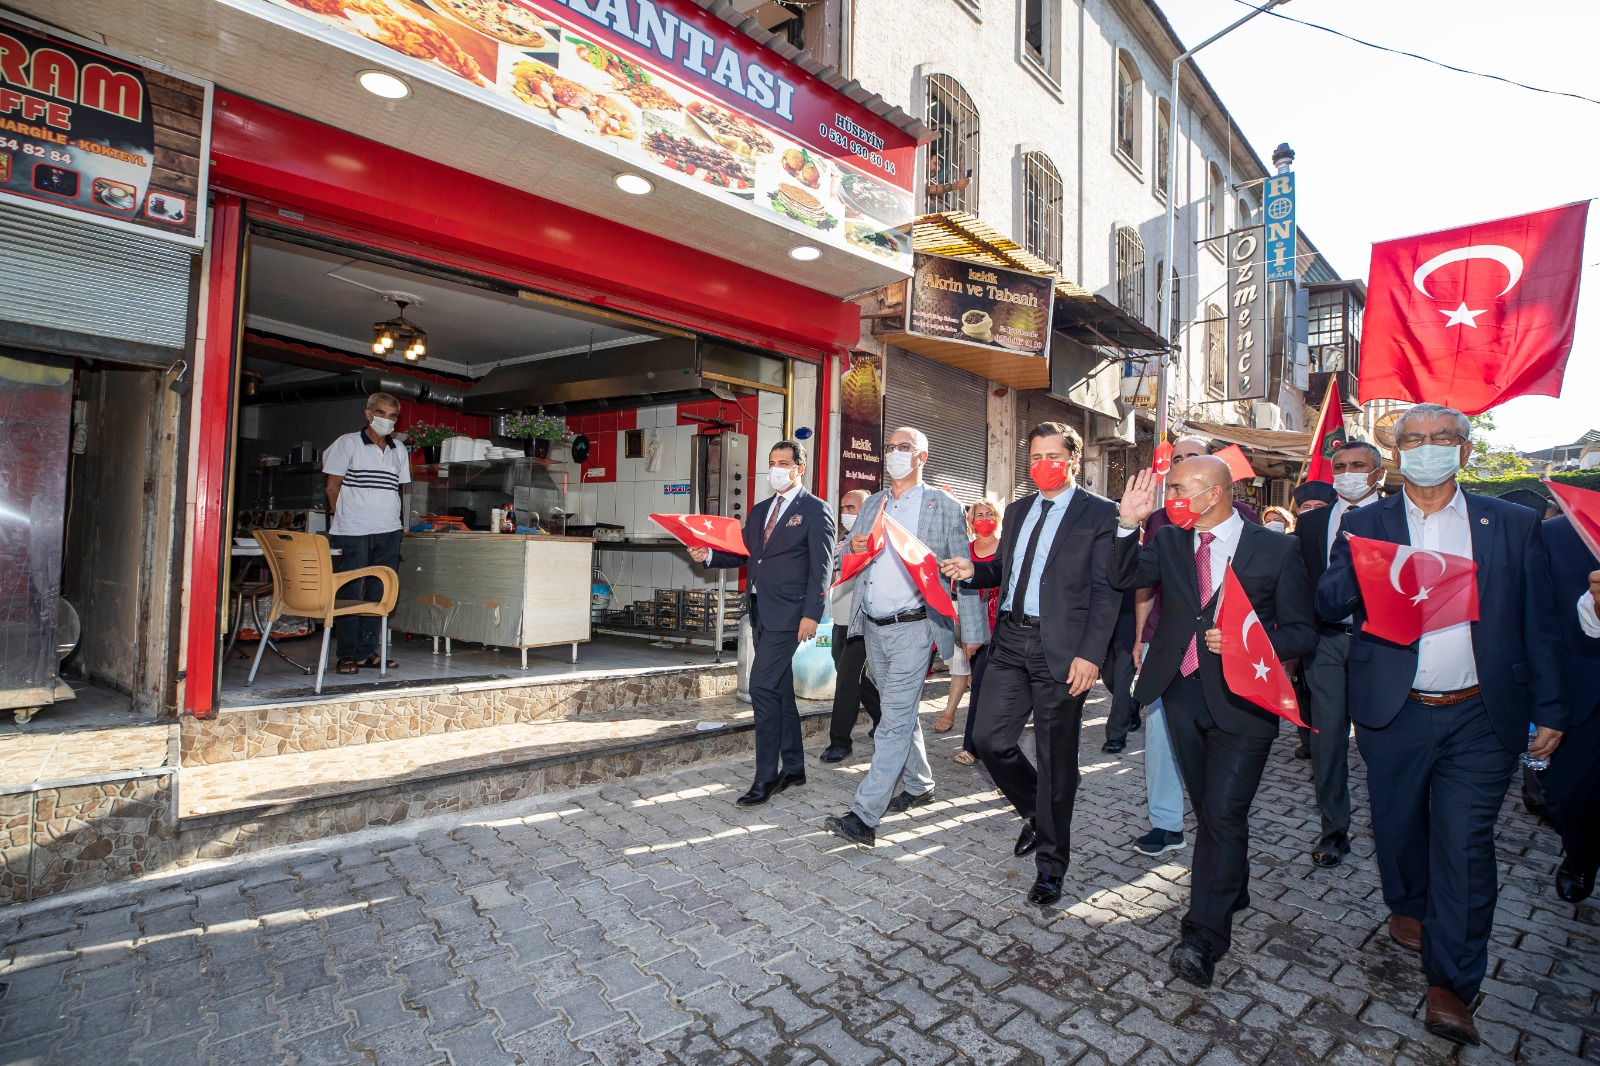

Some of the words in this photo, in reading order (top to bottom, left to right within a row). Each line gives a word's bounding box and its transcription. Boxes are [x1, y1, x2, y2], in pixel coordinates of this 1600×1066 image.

[835, 113, 884, 152] HÜSEYİN
[22, 143, 46, 158] 82
[49, 149, 73, 165] 84
[79, 138, 147, 167] KOKTEYL
[819, 123, 828, 138] 0
[849, 140, 869, 160] 930
[869, 151, 883, 168] 30
[884, 159, 896, 176] 14
[966, 283, 983, 298] ve
